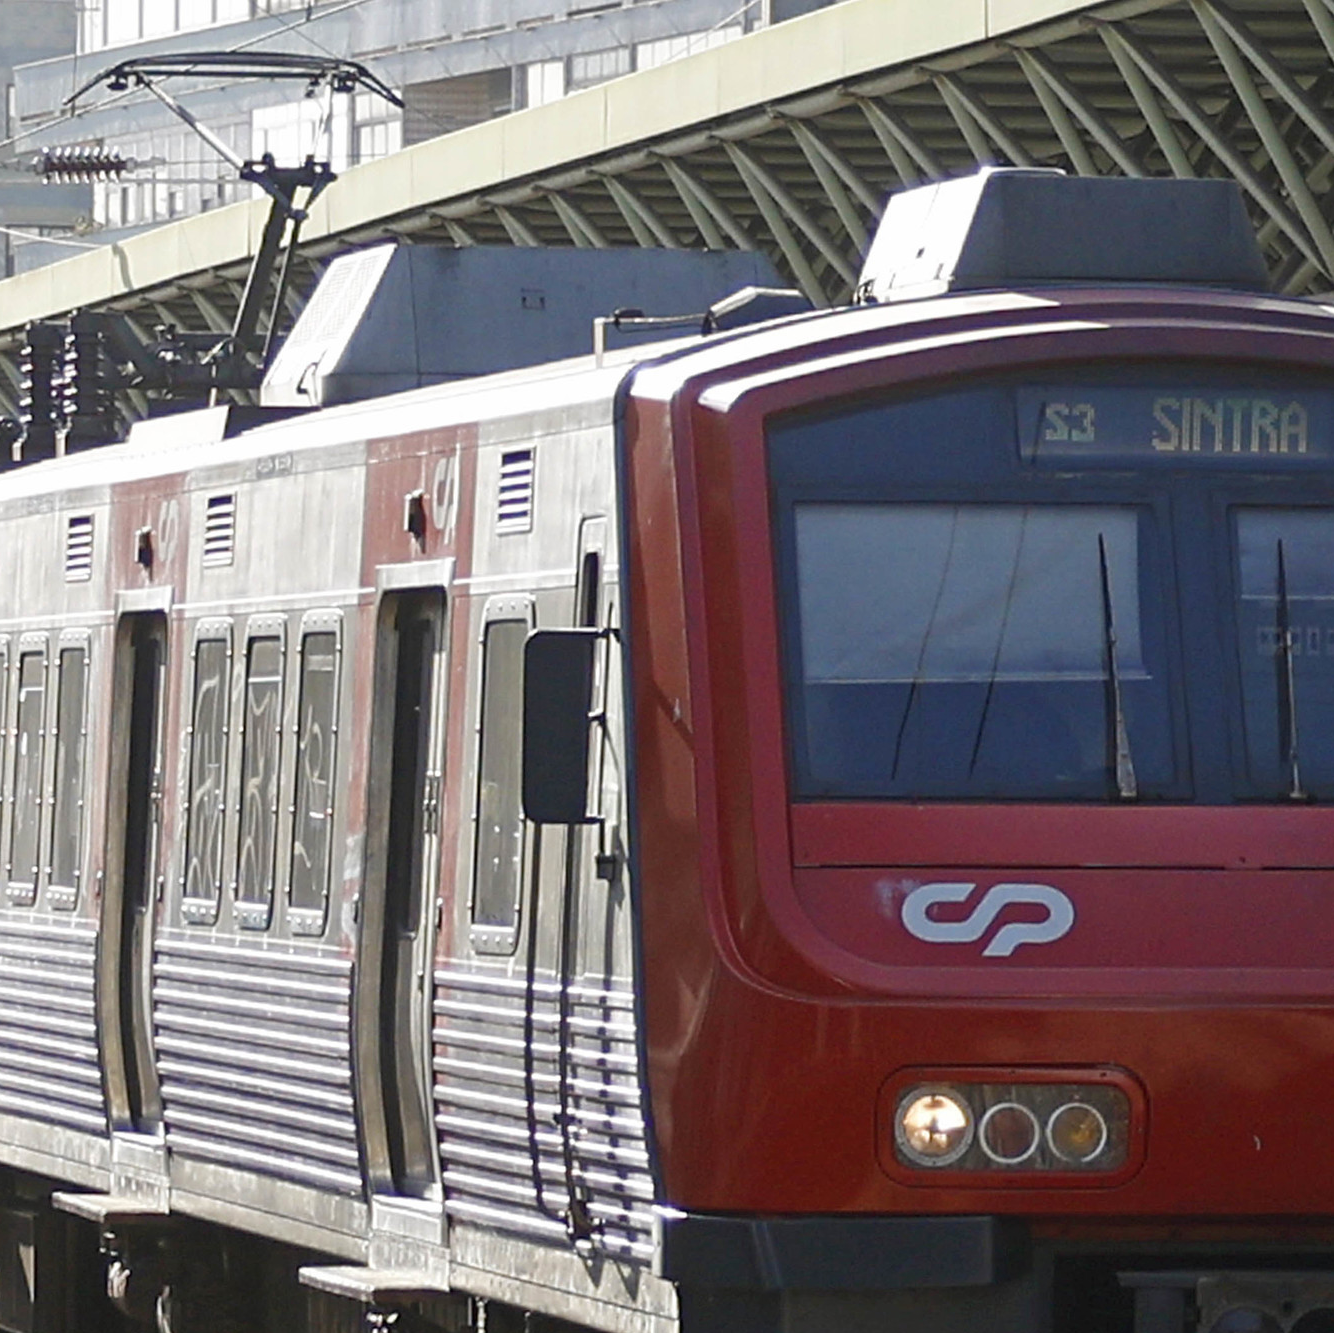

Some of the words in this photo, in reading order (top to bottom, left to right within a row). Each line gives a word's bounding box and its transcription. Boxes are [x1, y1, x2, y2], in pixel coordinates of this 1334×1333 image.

[1045, 403, 1095, 441] S3
[1151, 398, 1308, 453] SINTRA
[901, 883, 1075, 956] CP
